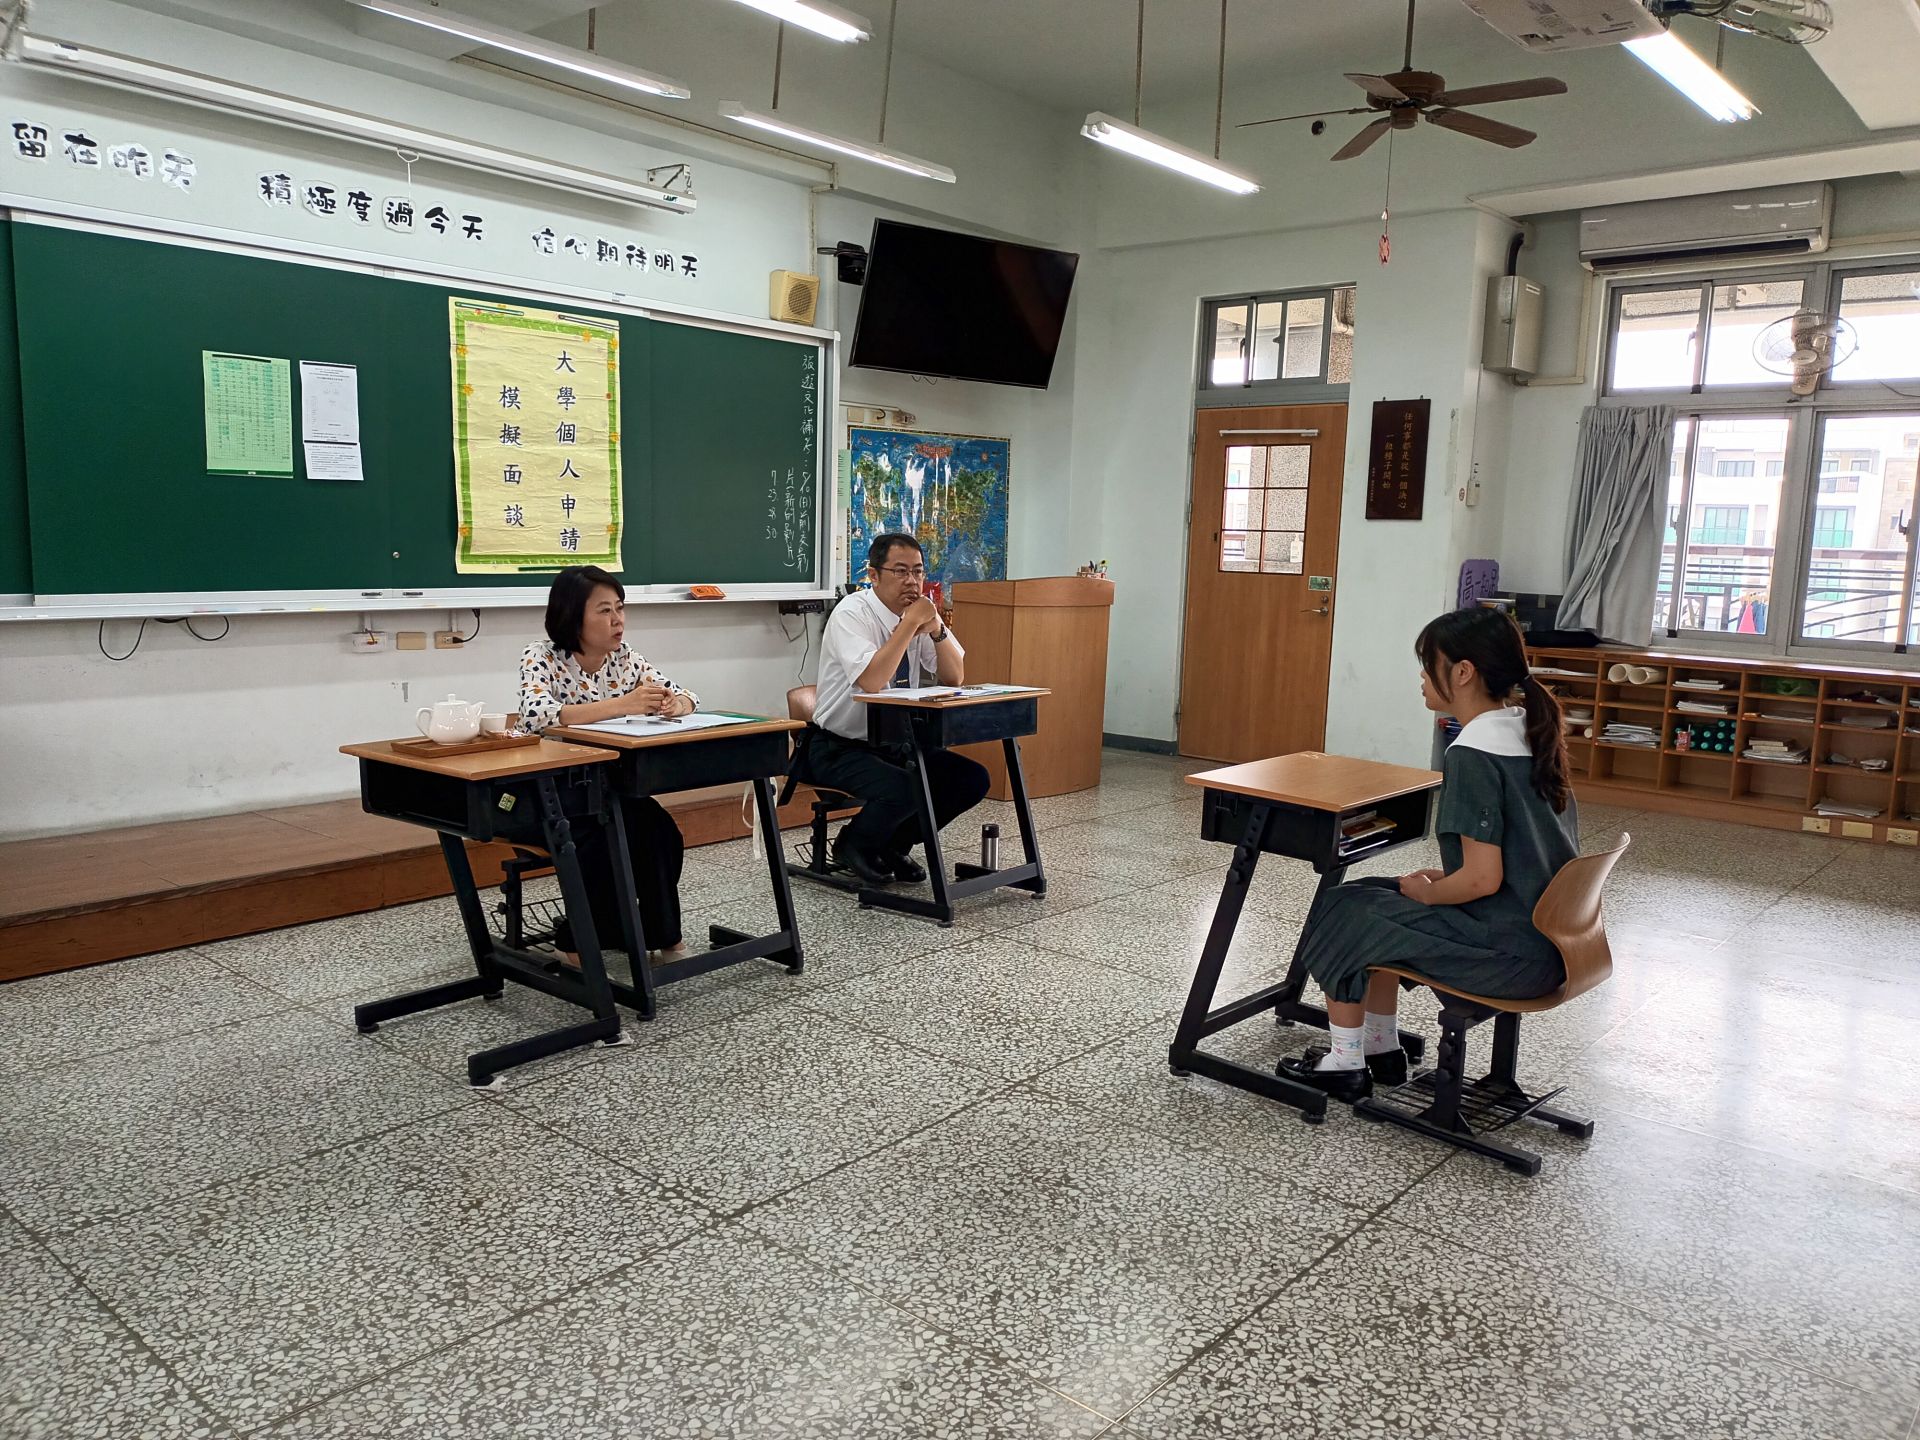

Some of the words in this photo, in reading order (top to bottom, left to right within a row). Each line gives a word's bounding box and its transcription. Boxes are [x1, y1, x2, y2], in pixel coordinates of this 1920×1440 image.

[12, 121, 197, 188] 留在昨天
[260, 173, 484, 242] 積極度過今天
[532, 228, 698, 279] 信心期待明天
[499, 385, 525, 527] 模擬面談
[556, 351, 580, 552] 大學個人申請
